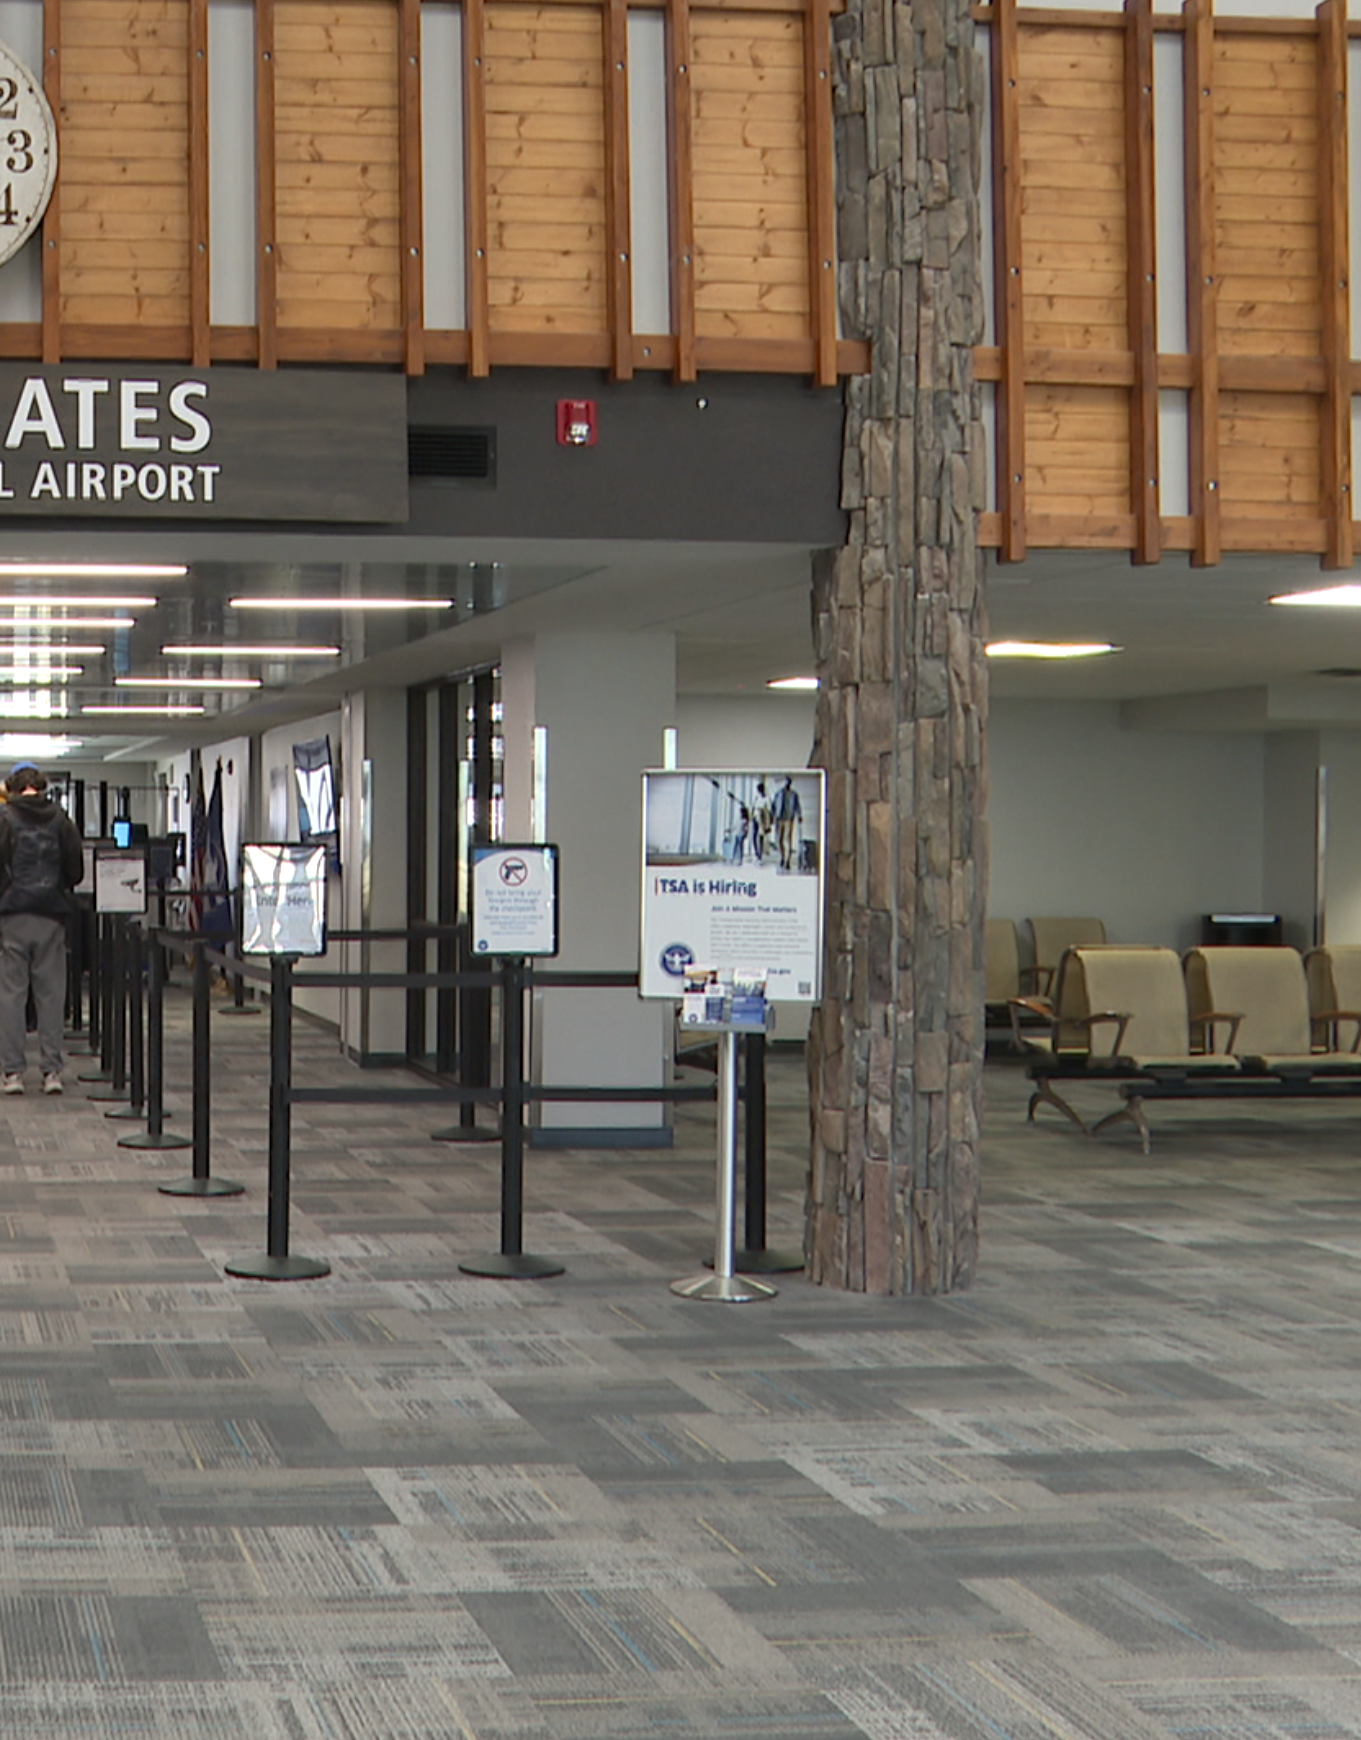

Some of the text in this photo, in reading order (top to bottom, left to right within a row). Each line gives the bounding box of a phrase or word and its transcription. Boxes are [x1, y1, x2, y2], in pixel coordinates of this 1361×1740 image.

[6, 129, 34, 173] 3
[30, 462, 221, 502] AIRPORT
[660, 879, 757, 897] TSA is Hiring
